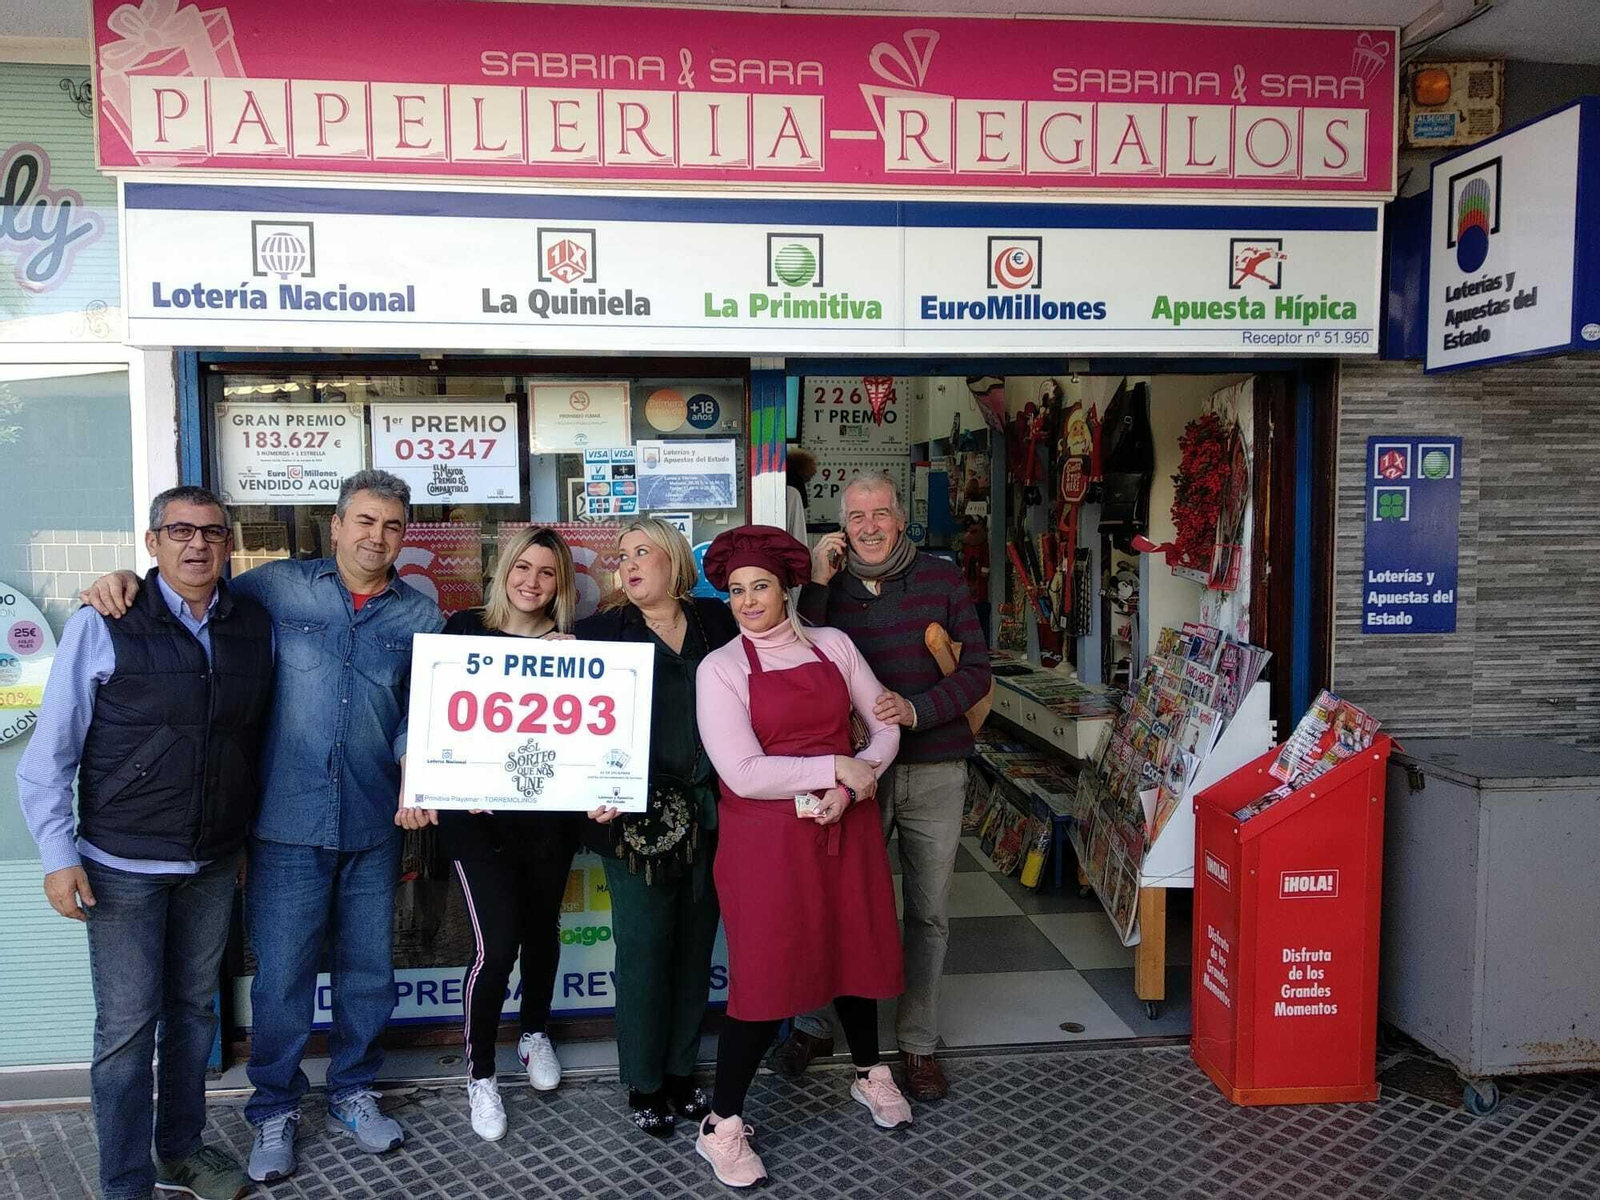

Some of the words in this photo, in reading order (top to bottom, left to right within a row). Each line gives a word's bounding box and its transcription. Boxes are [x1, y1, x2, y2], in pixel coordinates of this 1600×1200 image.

[480, 50, 666, 82] SABRINA
[678, 49, 696, 89] &
[709, 58, 823, 86] SARA
[1053, 68, 1220, 95] SABRINA
[1230, 64, 1247, 104] &
[1260, 74, 1365, 100] SARA
[899, 110, 1367, 182] REGALOS
[1446, 275, 1502, 303] Loterías
[1506, 272, 1516, 292] y
[152, 281, 268, 310] Lotería
[280, 284, 416, 313] Nacional
[482, 289, 521, 314] La
[528, 288, 652, 318] Quiniela
[705, 293, 741, 317] La
[749, 293, 883, 320] Primitiva
[920, 295, 1107, 321] EuroMillones
[1151, 295, 1266, 326] Apuesta
[1274, 292, 1358, 326] Hípica
[1445, 299, 1510, 329] Apuestas
[1514, 286, 1538, 310] del
[1242, 331, 1299, 347] Receptor
[1323, 331, 1370, 345] 51.950
[1444, 325, 1491, 350] Estado
[813, 387, 897, 405] 2264
[690, 401, 714, 414] +18
[829, 409, 897, 424] PREMO
[232, 414, 280, 426] GRAN
[286, 414, 346, 426] PREMIO
[382, 415, 403, 433] 1er
[411, 415, 507, 433] PREMIO
[692, 413, 713, 421] años
[243, 431, 330, 449] 183.627
[334, 439, 342, 448] €
[395, 438, 497, 460] 03347
[588, 451, 608, 459] VISA
[614, 450, 634, 458] VISA
[267, 469, 287, 477] Euro
[304, 469, 338, 477] Millones
[433, 471, 457, 486] PREMIO
[440, 464, 463, 477] MAYOR
[239, 480, 303, 490] VENDIDO
[427, 482, 469, 496] COMPARTIRLO
[1369, 569, 1423, 584] Loterías
[1426, 571, 1435, 585] y
[1367, 591, 1429, 608] Apuestas
[1433, 589, 1454, 604] del
[1367, 611, 1413, 626] Estado
[14, 627, 37, 638] 25€
[466, 652, 494, 675] 5º
[503, 654, 606, 680] PREMIO
[447, 690, 617, 736] 06293
[518, 738, 541, 754] EL
[504, 750, 557, 772] SORTEO
[517, 767, 535, 777] QUE
[536, 763, 555, 778] NOS
[511, 775, 544, 797] UNE
[484, 796, 537, 804] TORREMOLINOS
[1206, 856, 1228, 885] ¡HOLA!
[1283, 875, 1333, 893] ¡HOLA!
[560, 925, 612, 947] oigo
[1207, 923, 1230, 952] Disfruta
[1210, 946, 1218, 959] de
[1218, 953, 1226, 969] los
[1282, 947, 1332, 963] Disfruta
[1206, 958, 1229, 989] Grandes
[1288, 965, 1303, 980] de
[1306, 965, 1325, 980] los
[1203, 972, 1230, 1009] Momentos
[1281, 982, 1332, 999] Grandes
[1274, 1001, 1338, 1017] Momentos
